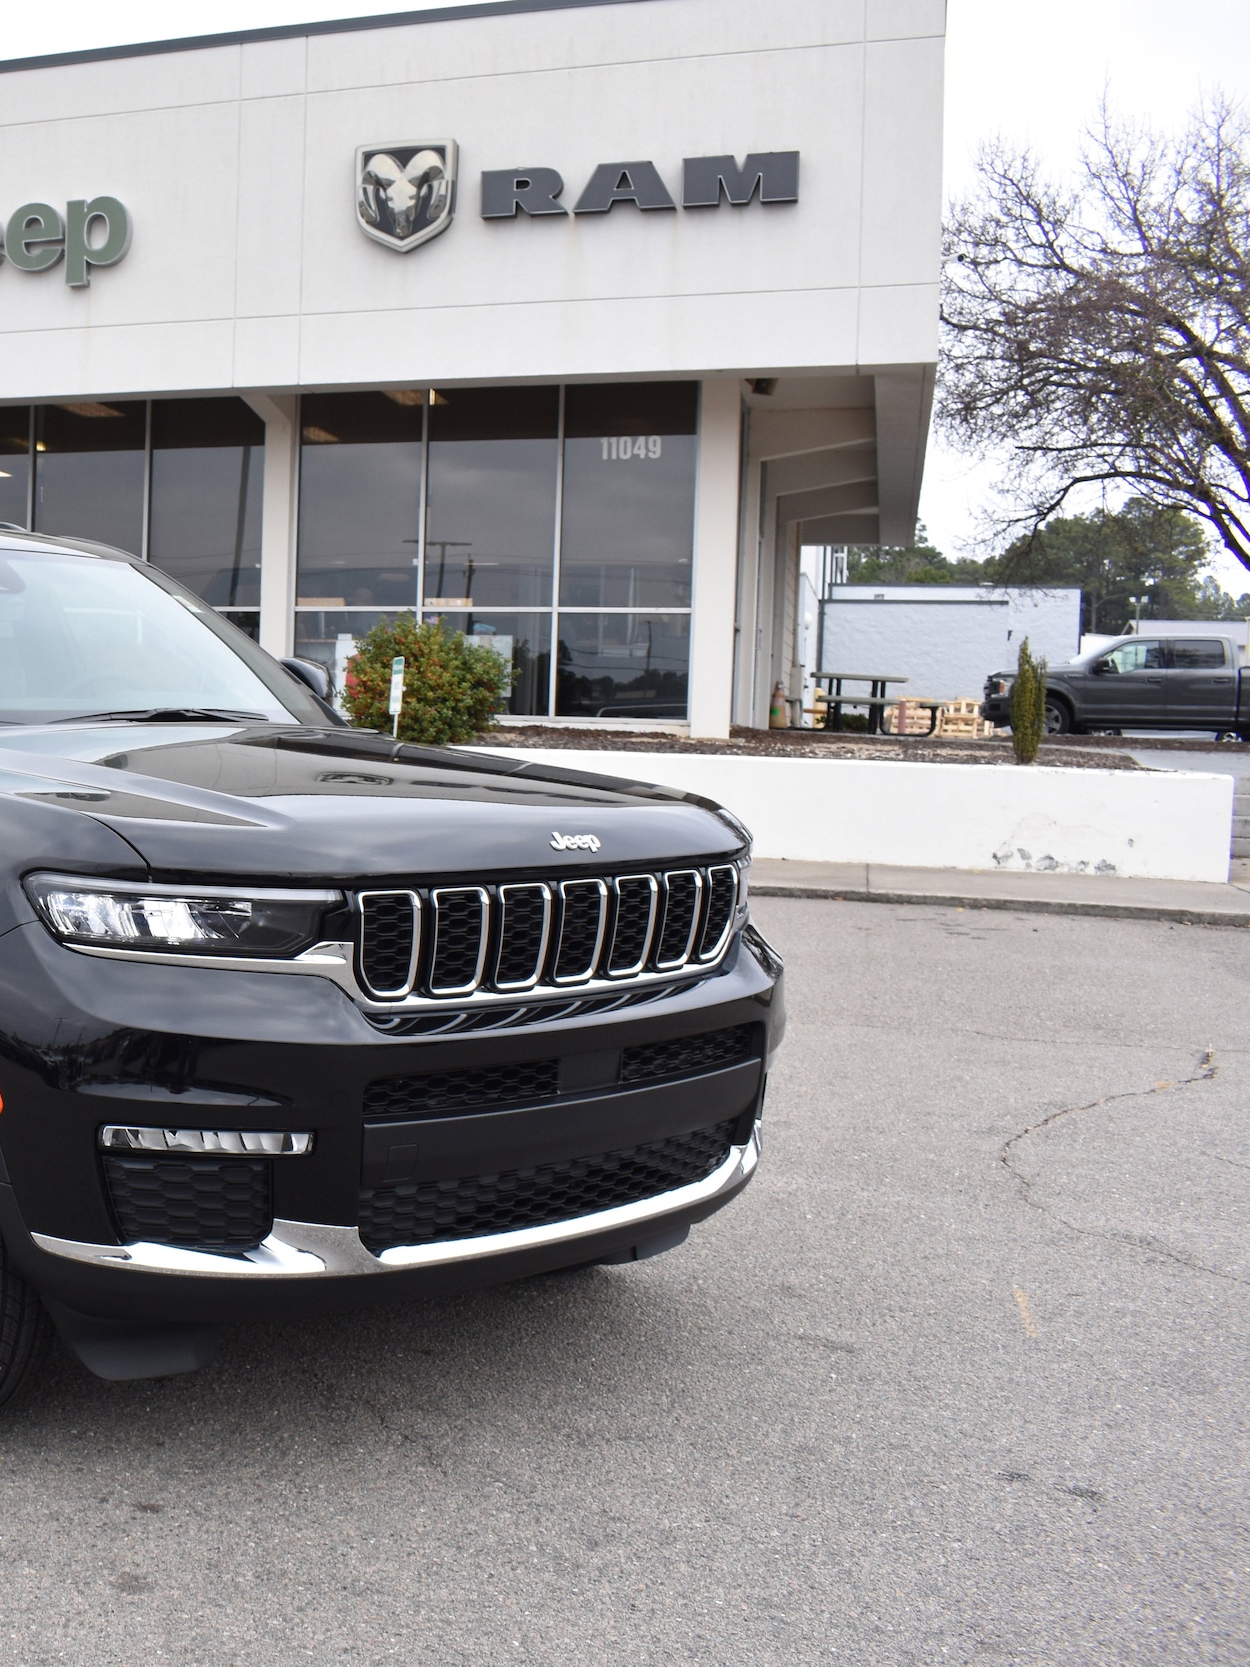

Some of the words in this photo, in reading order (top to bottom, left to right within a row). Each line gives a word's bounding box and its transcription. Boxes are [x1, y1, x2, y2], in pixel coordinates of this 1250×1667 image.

[481, 151, 800, 218] RAM
[600, 435, 661, 459] 11049
[549, 831, 601, 853] Jeep
